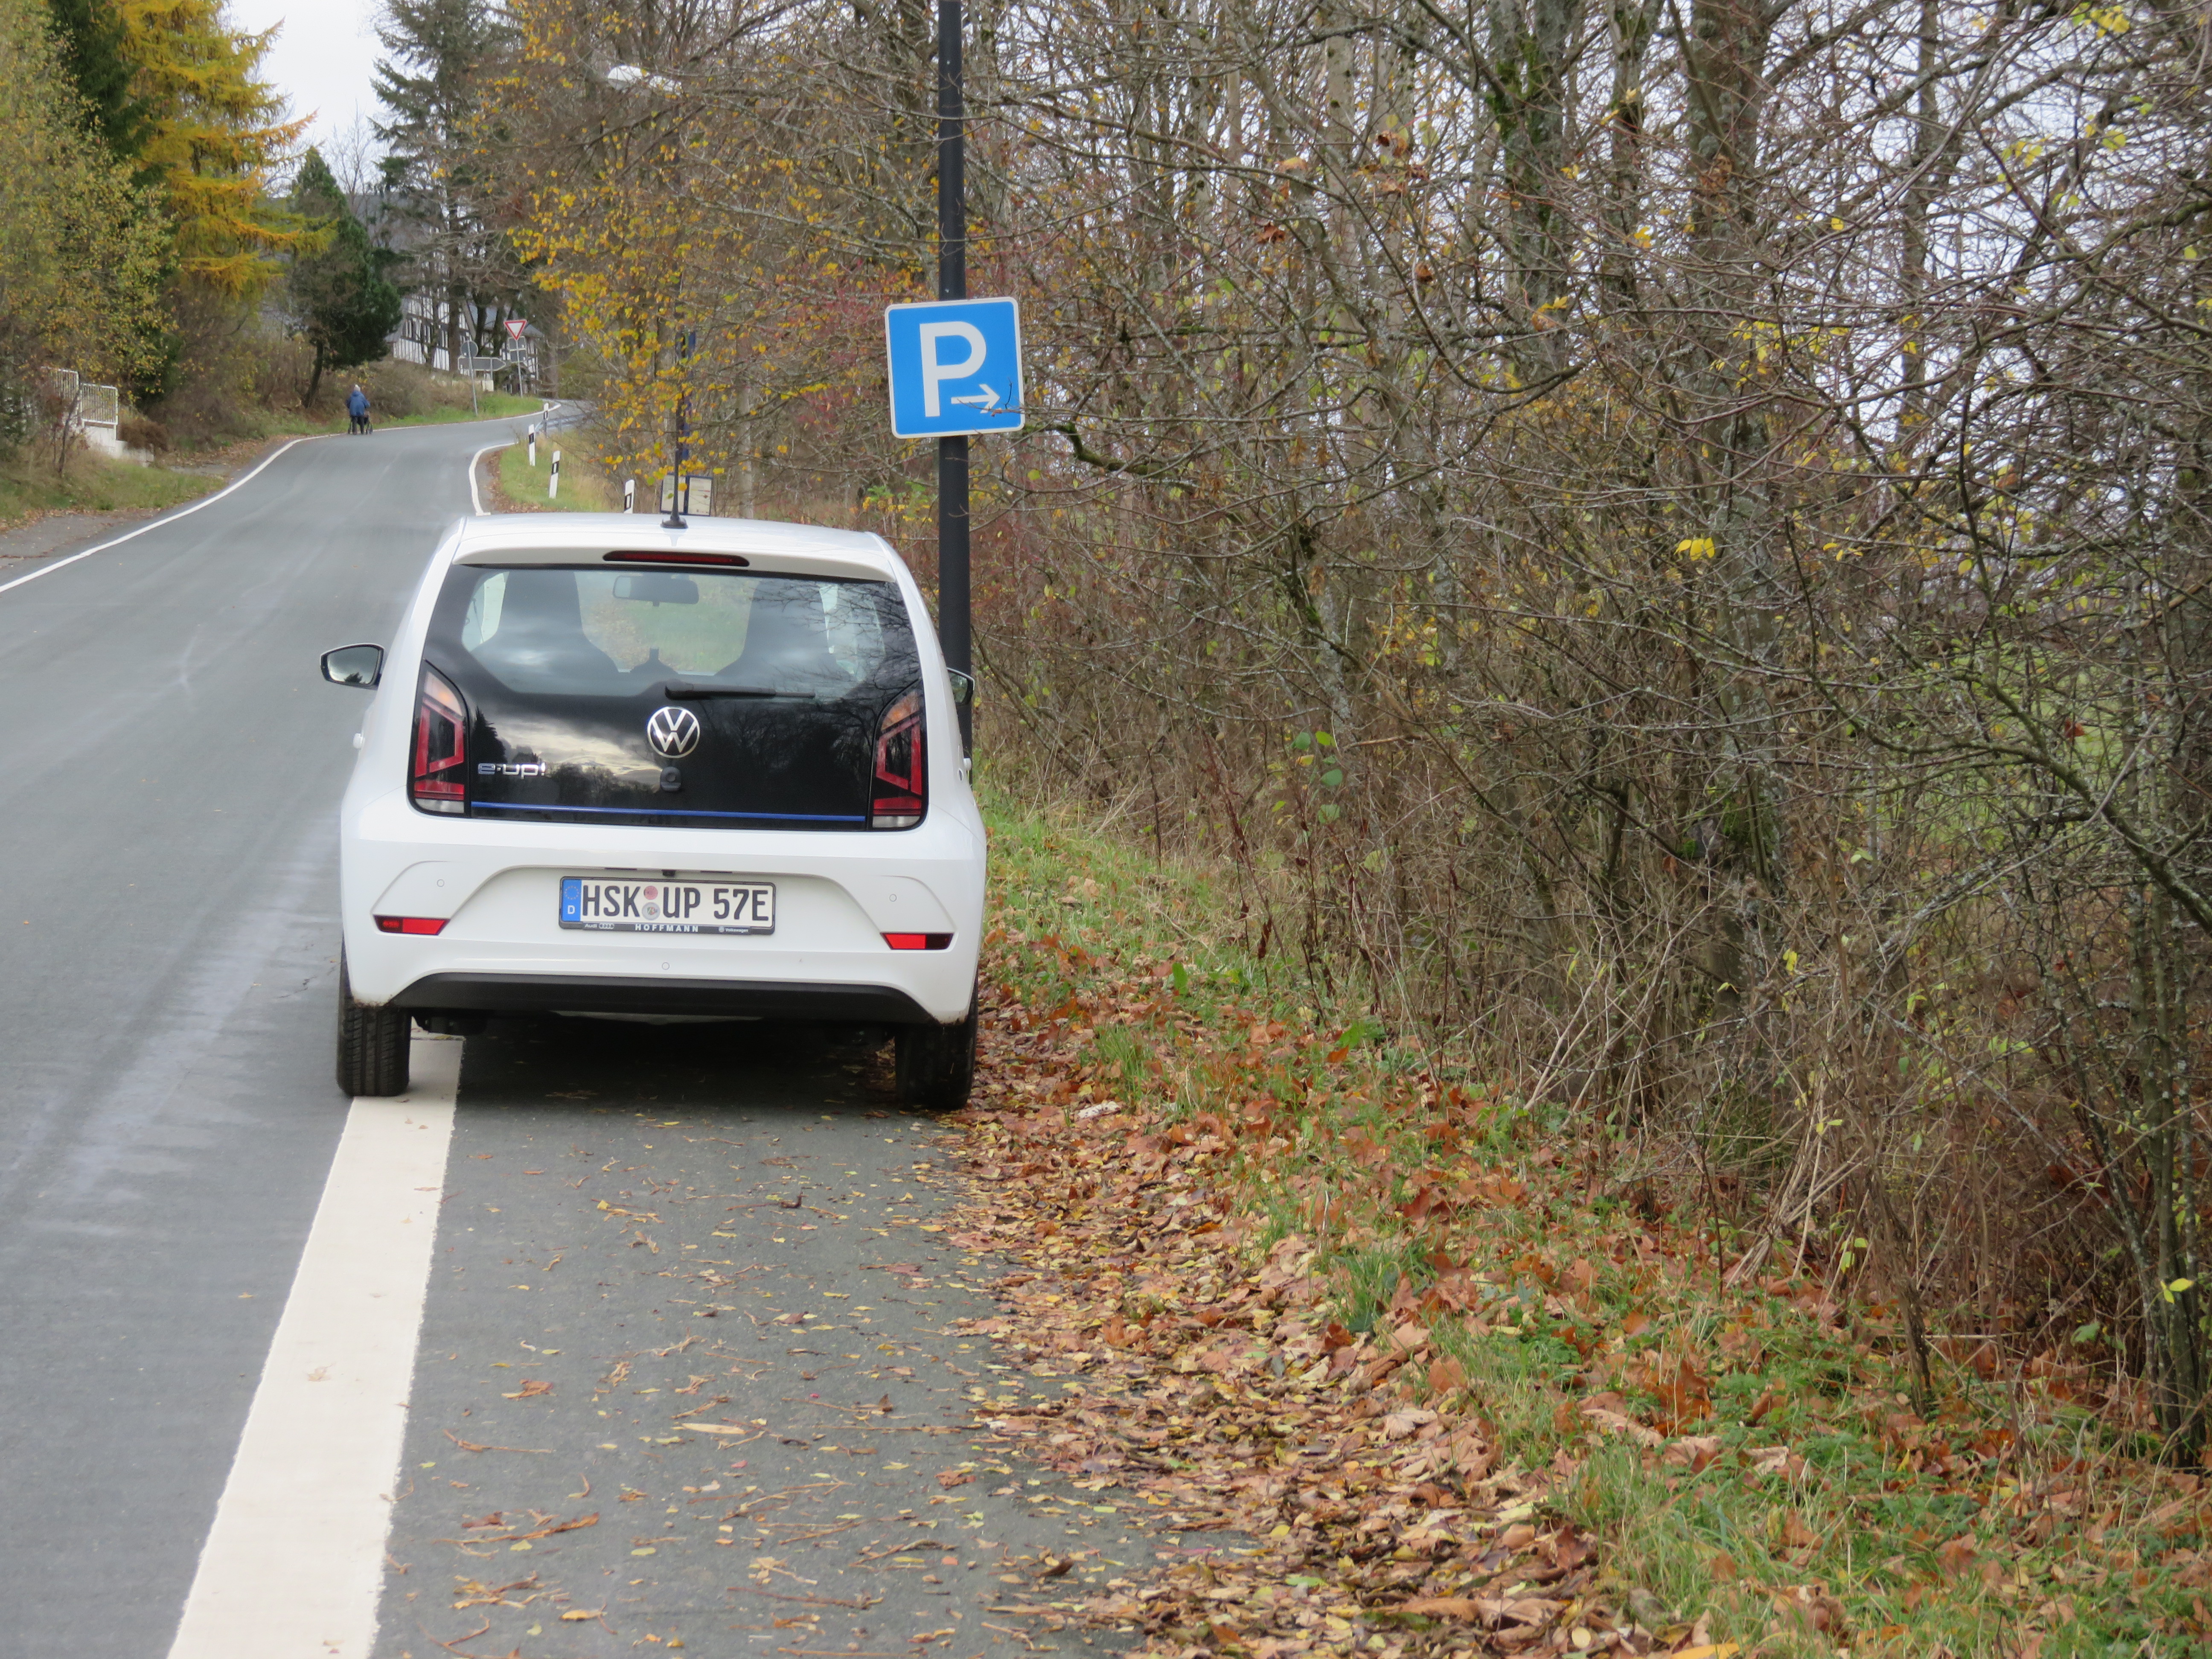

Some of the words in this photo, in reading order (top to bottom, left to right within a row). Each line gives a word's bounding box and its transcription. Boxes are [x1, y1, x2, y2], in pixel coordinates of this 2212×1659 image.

[920, 321, 987, 417] P
[568, 905, 575, 914] D
[582, 885, 640, 917] HSK
[663, 887, 700, 918] UP
[714, 888, 768, 920] 57E
[635, 924, 699, 932] HOFFMANN
